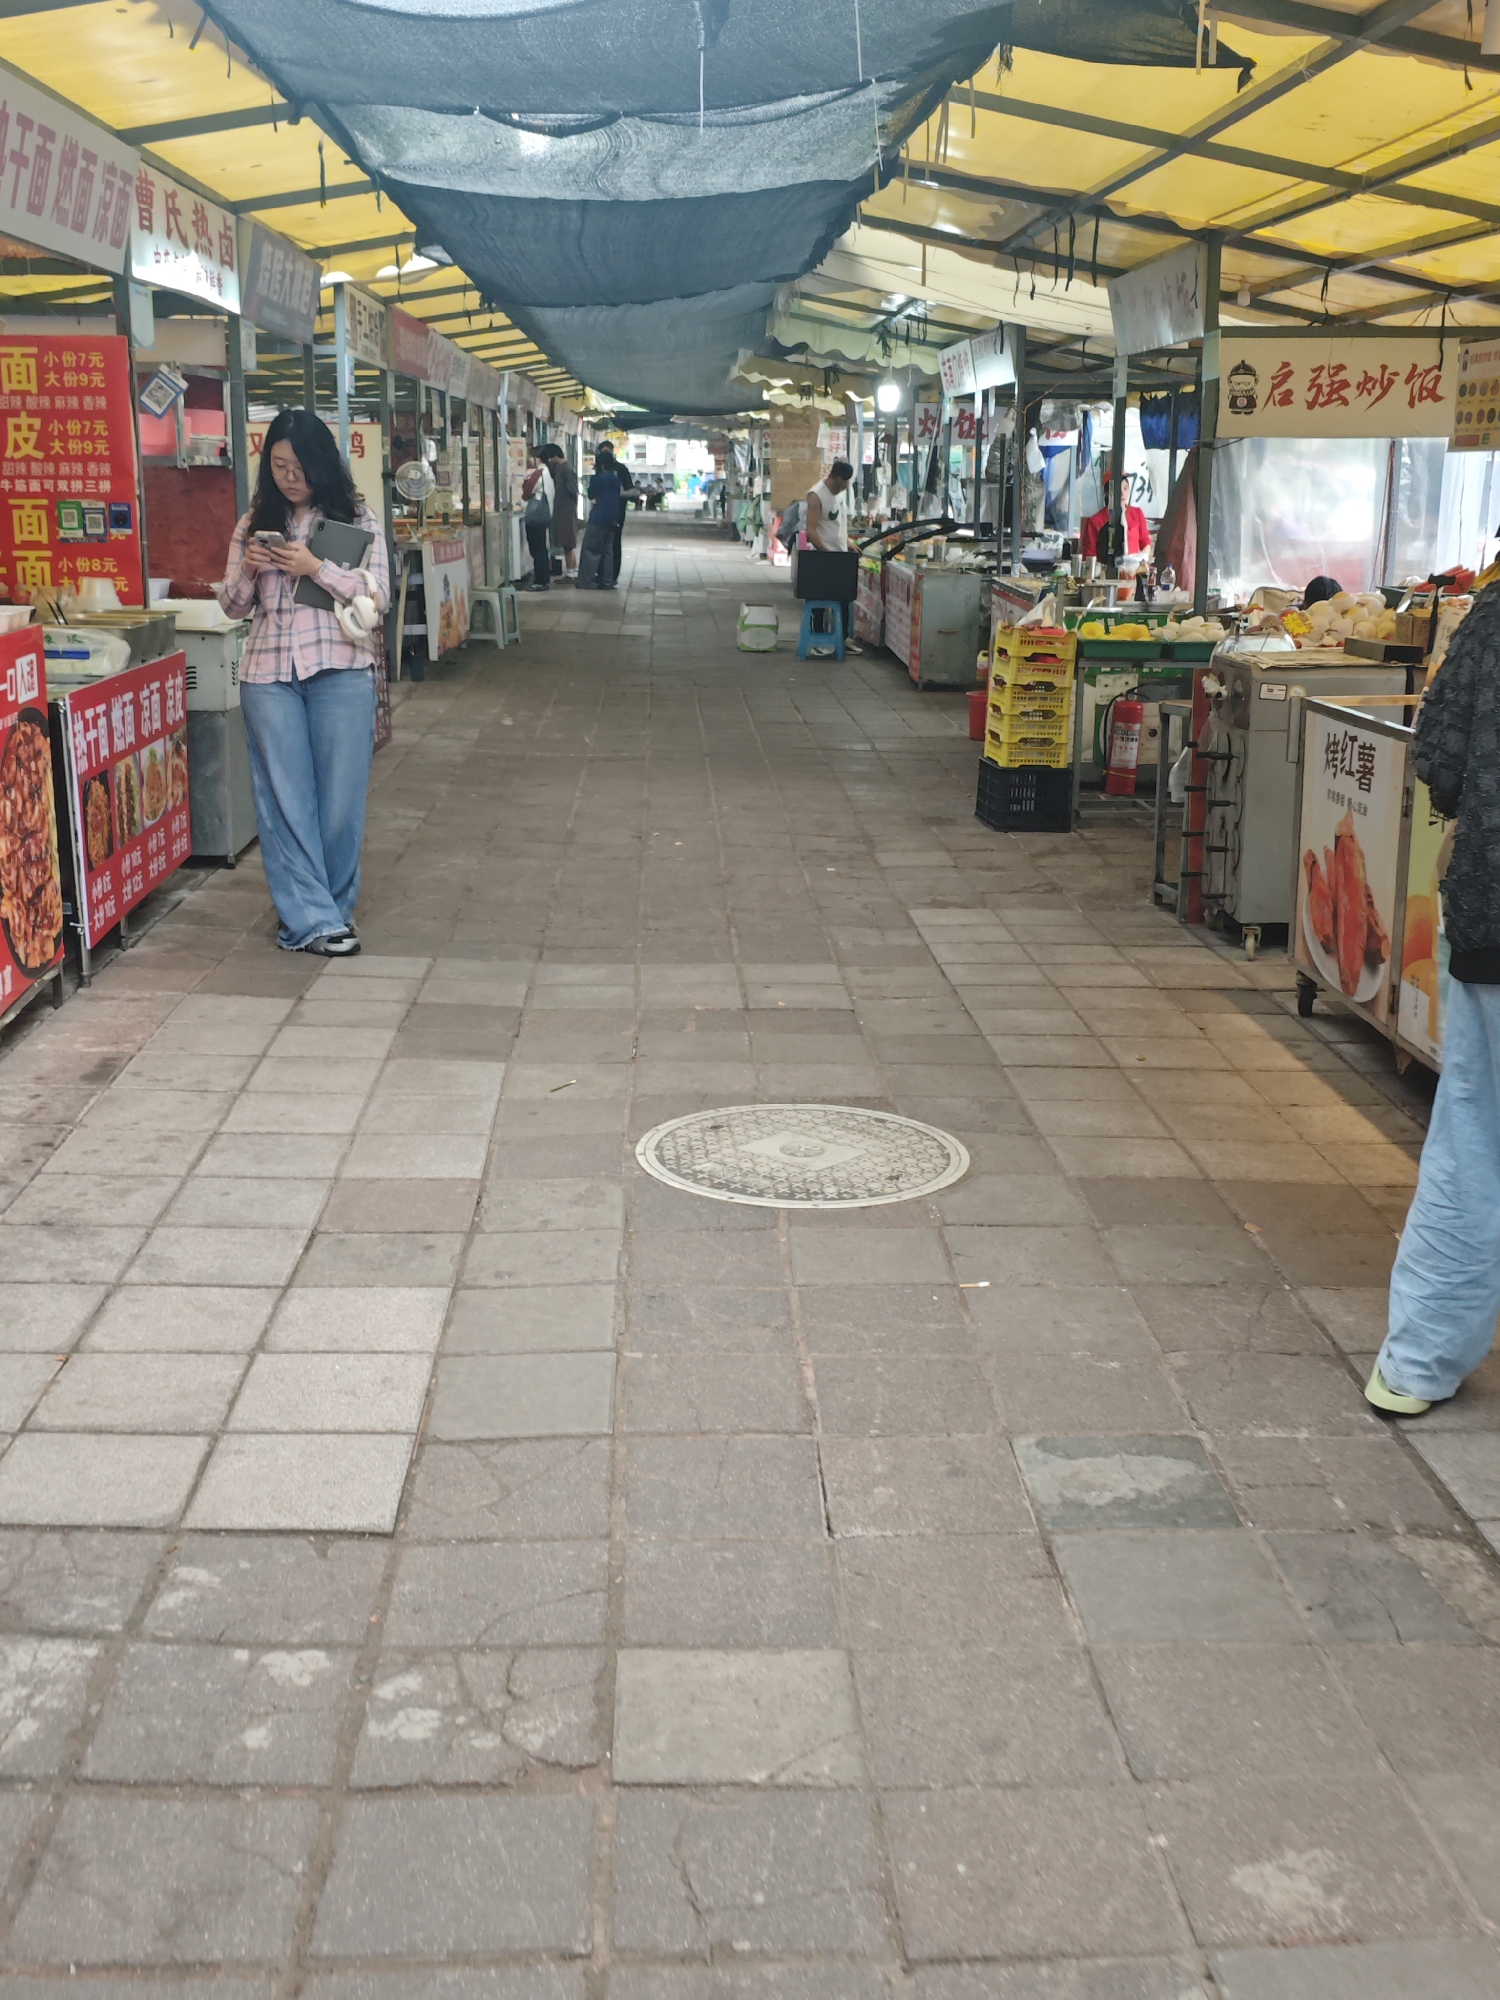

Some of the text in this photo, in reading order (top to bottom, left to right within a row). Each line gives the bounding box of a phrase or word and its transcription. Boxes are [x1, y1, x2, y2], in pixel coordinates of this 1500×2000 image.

[135, 168, 234, 272] 曹氏热卤
[43, 351, 105, 368] 小份7元
[44, 371, 106, 388] 大份9元
[1262, 361, 1447, 412] 启强炒饭
[4, 411, 45, 460] 皮
[48, 419, 109, 436] 小份7元
[49, 439, 110, 456] 大份9元
[8, 499, 49, 545] 面
[0, 550, 53, 593] 面
[58, 557, 118, 573] 小份8元
[74, 703, 110, 776] 热干面
[139, 680, 162, 739] 凉面
[165, 669, 184, 726] 凉皮
[1323, 730, 1376, 794] 烤红薯
